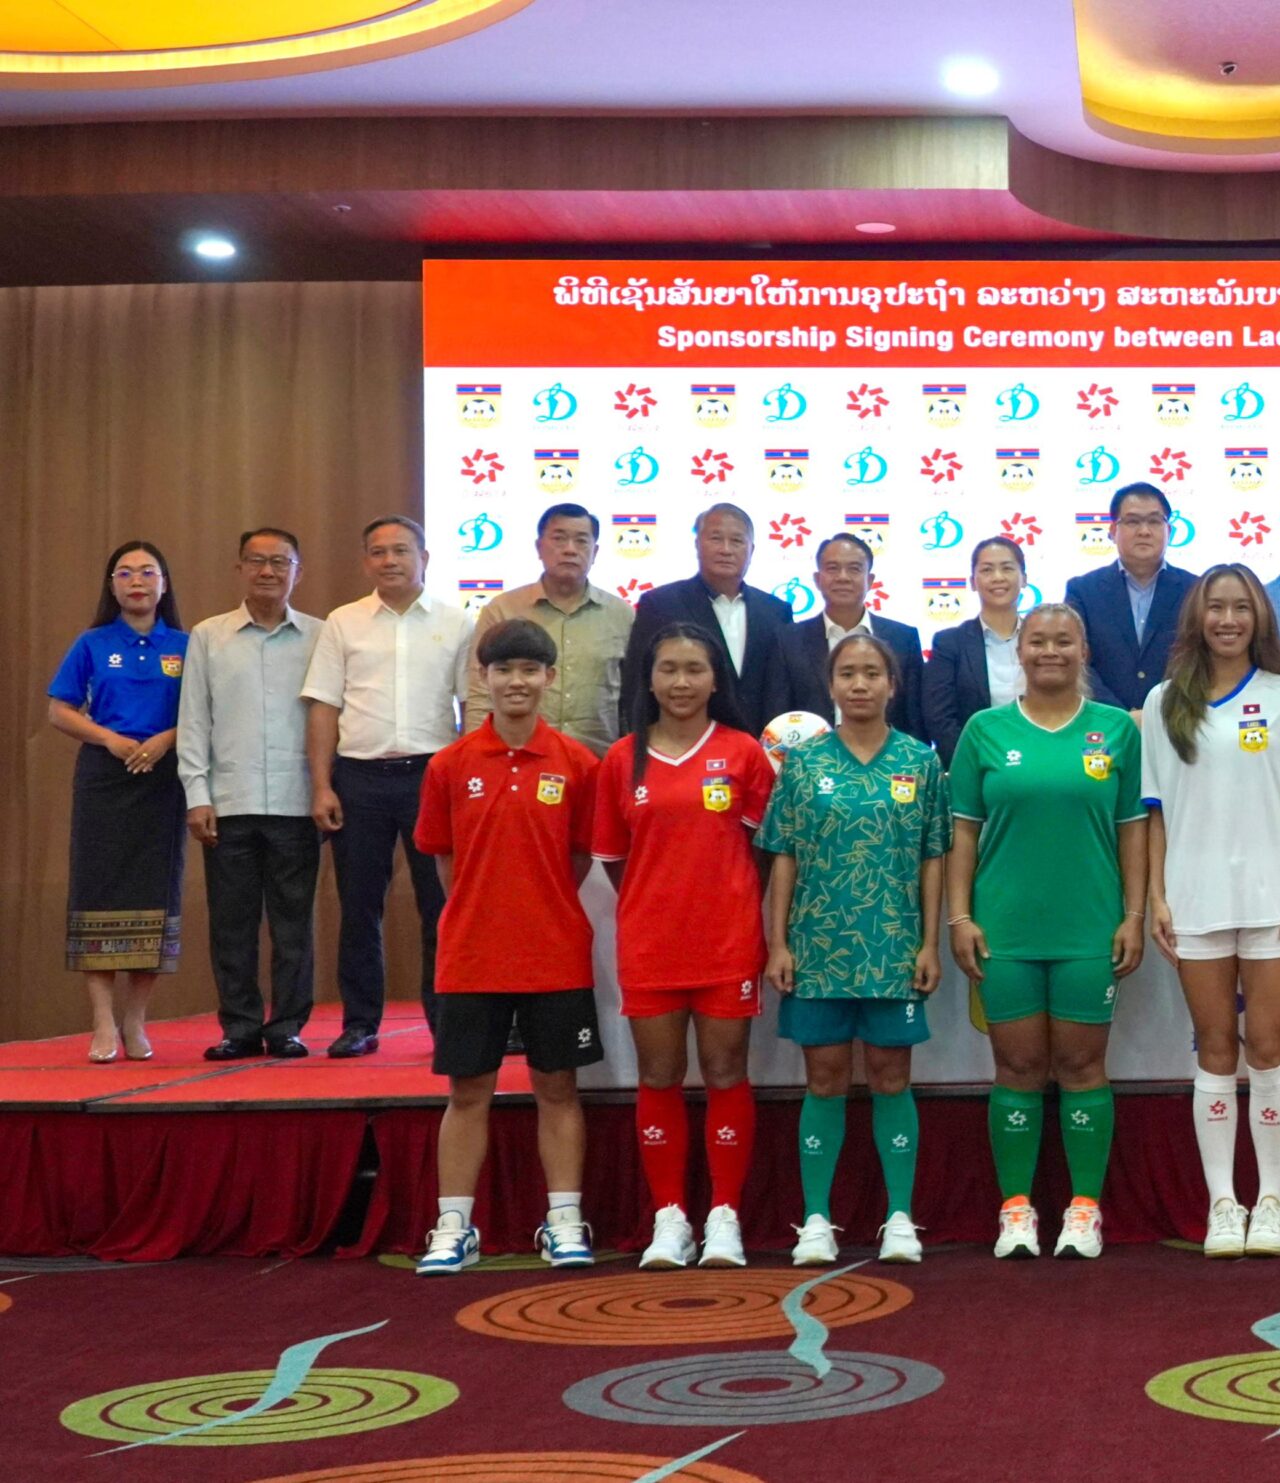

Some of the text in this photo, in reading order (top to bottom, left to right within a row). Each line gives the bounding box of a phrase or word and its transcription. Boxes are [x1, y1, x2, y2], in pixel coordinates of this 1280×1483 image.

[657, 325, 837, 353] Sponsorship
[845, 325, 954, 353] Signing
[963, 325, 1106, 353] Ceremony
[1113, 325, 1234, 348] between
